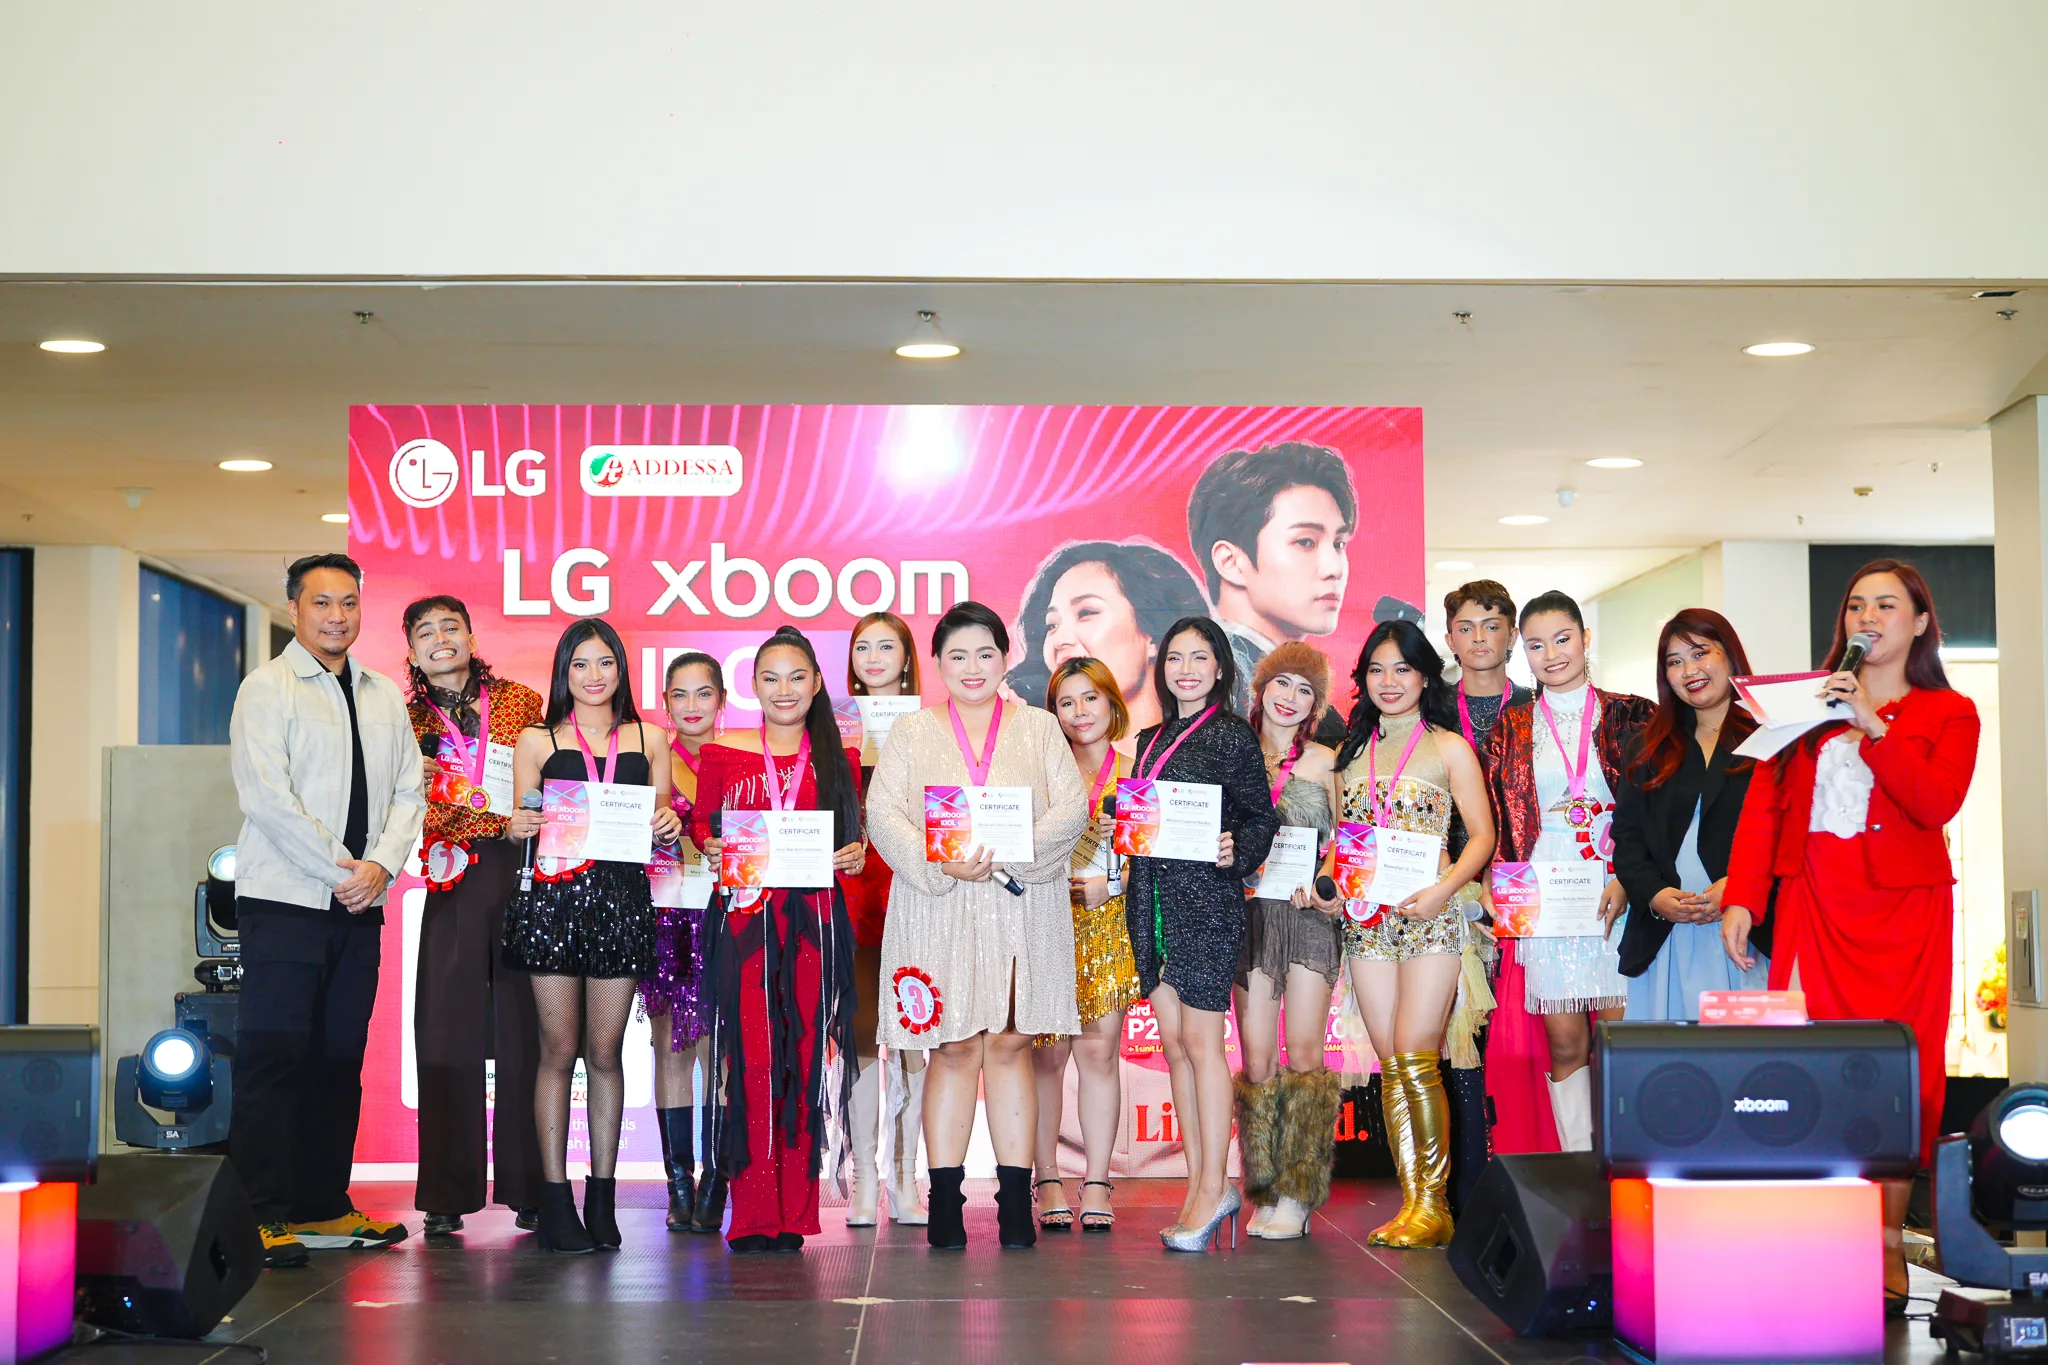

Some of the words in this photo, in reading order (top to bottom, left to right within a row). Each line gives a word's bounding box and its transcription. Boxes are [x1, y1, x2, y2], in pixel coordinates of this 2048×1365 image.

[627, 458, 734, 476] ADDESSA
[472, 448, 546, 497] LG
[503, 547, 611, 618] LG
[646, 542, 970, 619] xboom
[559, 805, 586, 813] xboom
[600, 800, 642, 810] CERTIFICATE
[979, 803, 1020, 811] CERTIFICATE
[1130, 804, 1157, 813] xboom
[1169, 799, 1210, 809] CERTIFICATE
[557, 813, 574, 821] IDOL
[1130, 812, 1146, 820] IDOL
[1273, 842, 1307, 851] CERTIFICATE
[1339, 846, 1349, 855] LG
[1349, 847, 1374, 858] xboom
[1387, 846, 1427, 859] CERTIFICATE
[1348, 856, 1363, 865] IDOL
[907, 984, 927, 1020] 3
[1733, 1096, 1790, 1113] xboom
[165, 1130, 180, 1138] SA
